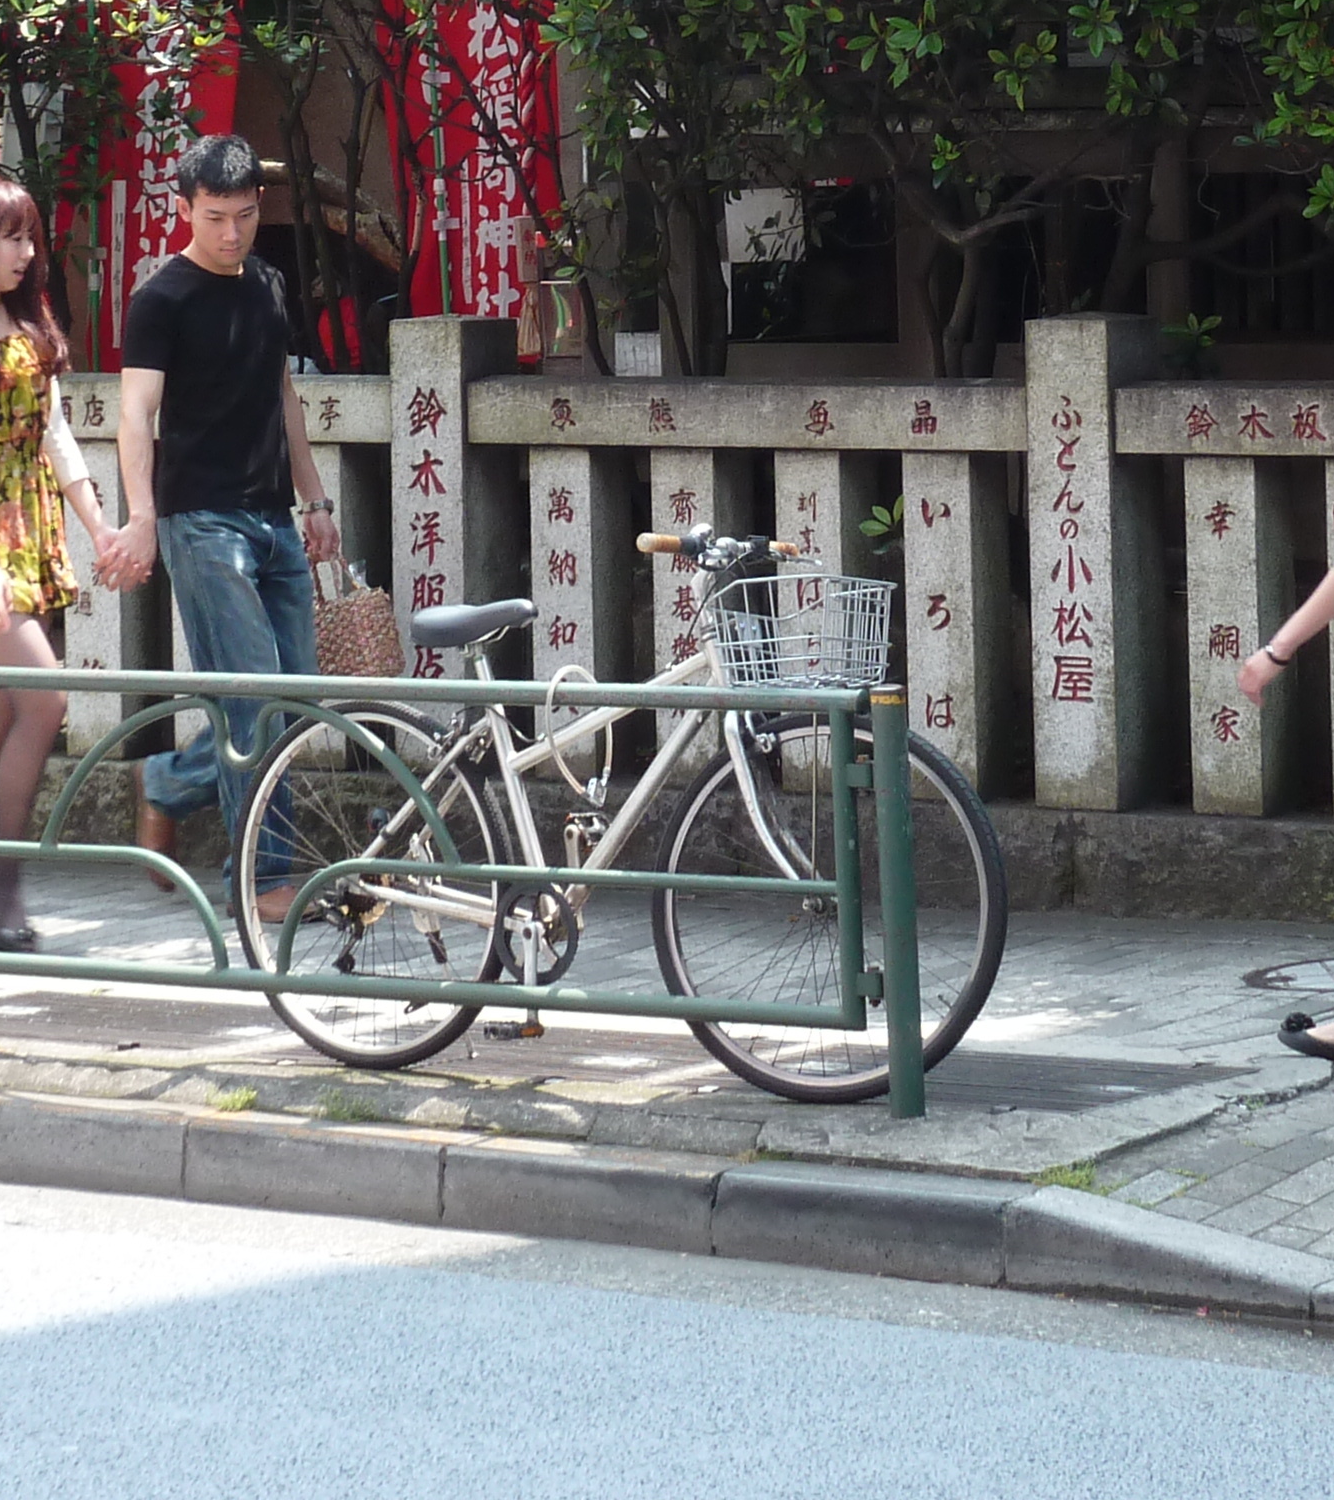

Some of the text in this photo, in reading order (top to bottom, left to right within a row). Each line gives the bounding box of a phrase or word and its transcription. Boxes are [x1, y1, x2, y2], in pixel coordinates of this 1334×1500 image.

[920, 498, 956, 729] いろは
[1050, 395, 1096, 704] ふとんの小松屋
